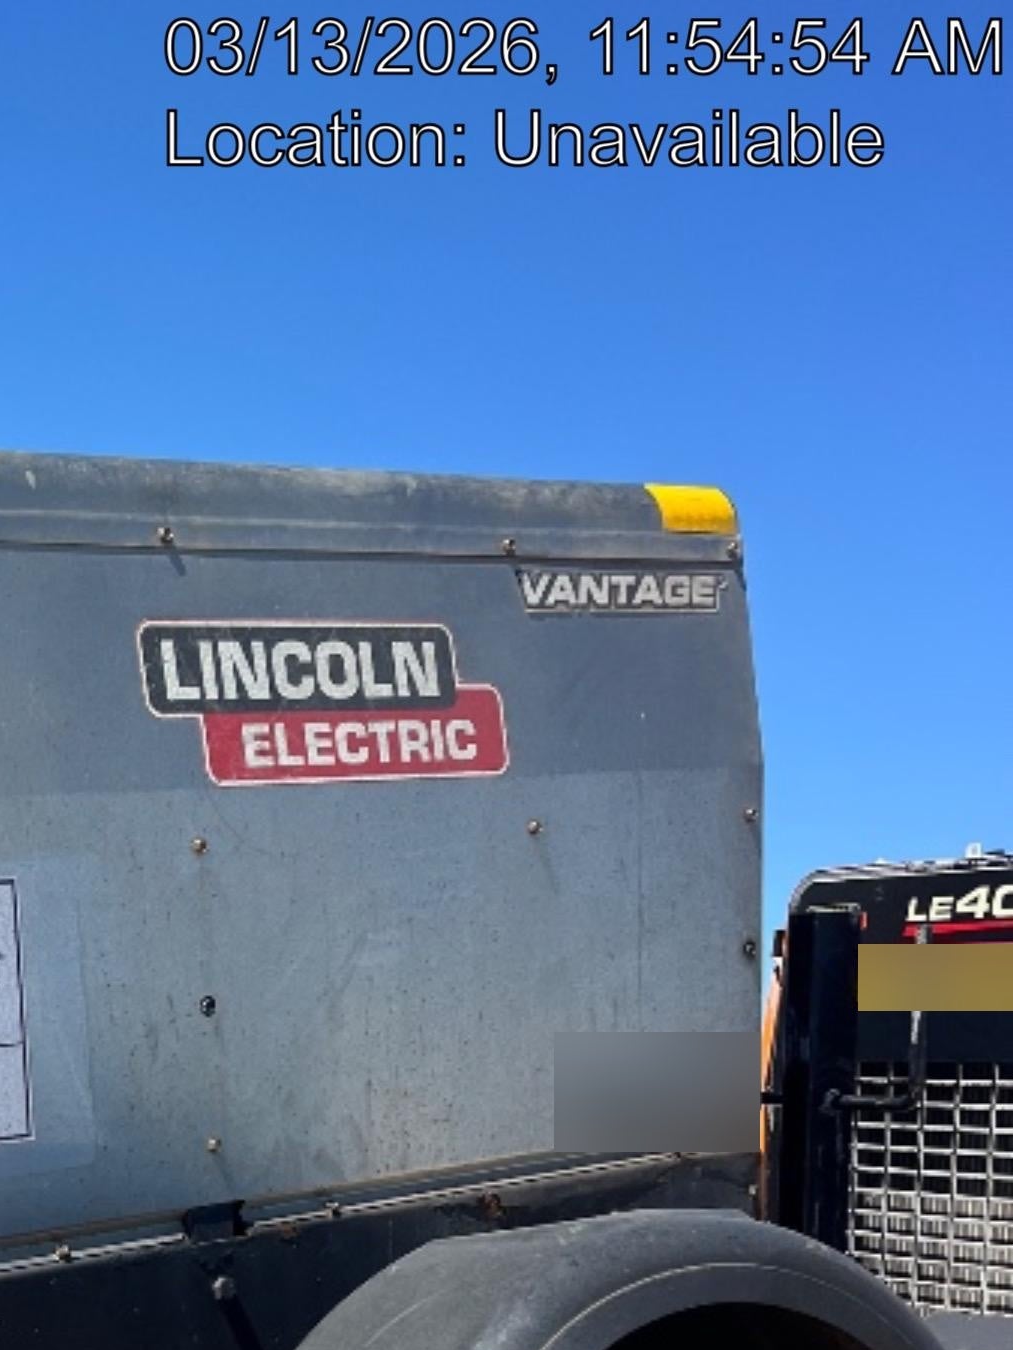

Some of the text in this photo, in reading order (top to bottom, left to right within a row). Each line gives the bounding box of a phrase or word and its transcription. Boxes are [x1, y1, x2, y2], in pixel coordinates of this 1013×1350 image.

[521, 571, 718, 607] VANTAGE
[159, 639, 442, 701] LINCOLN
[240, 718, 478, 769] ELECTRIC
